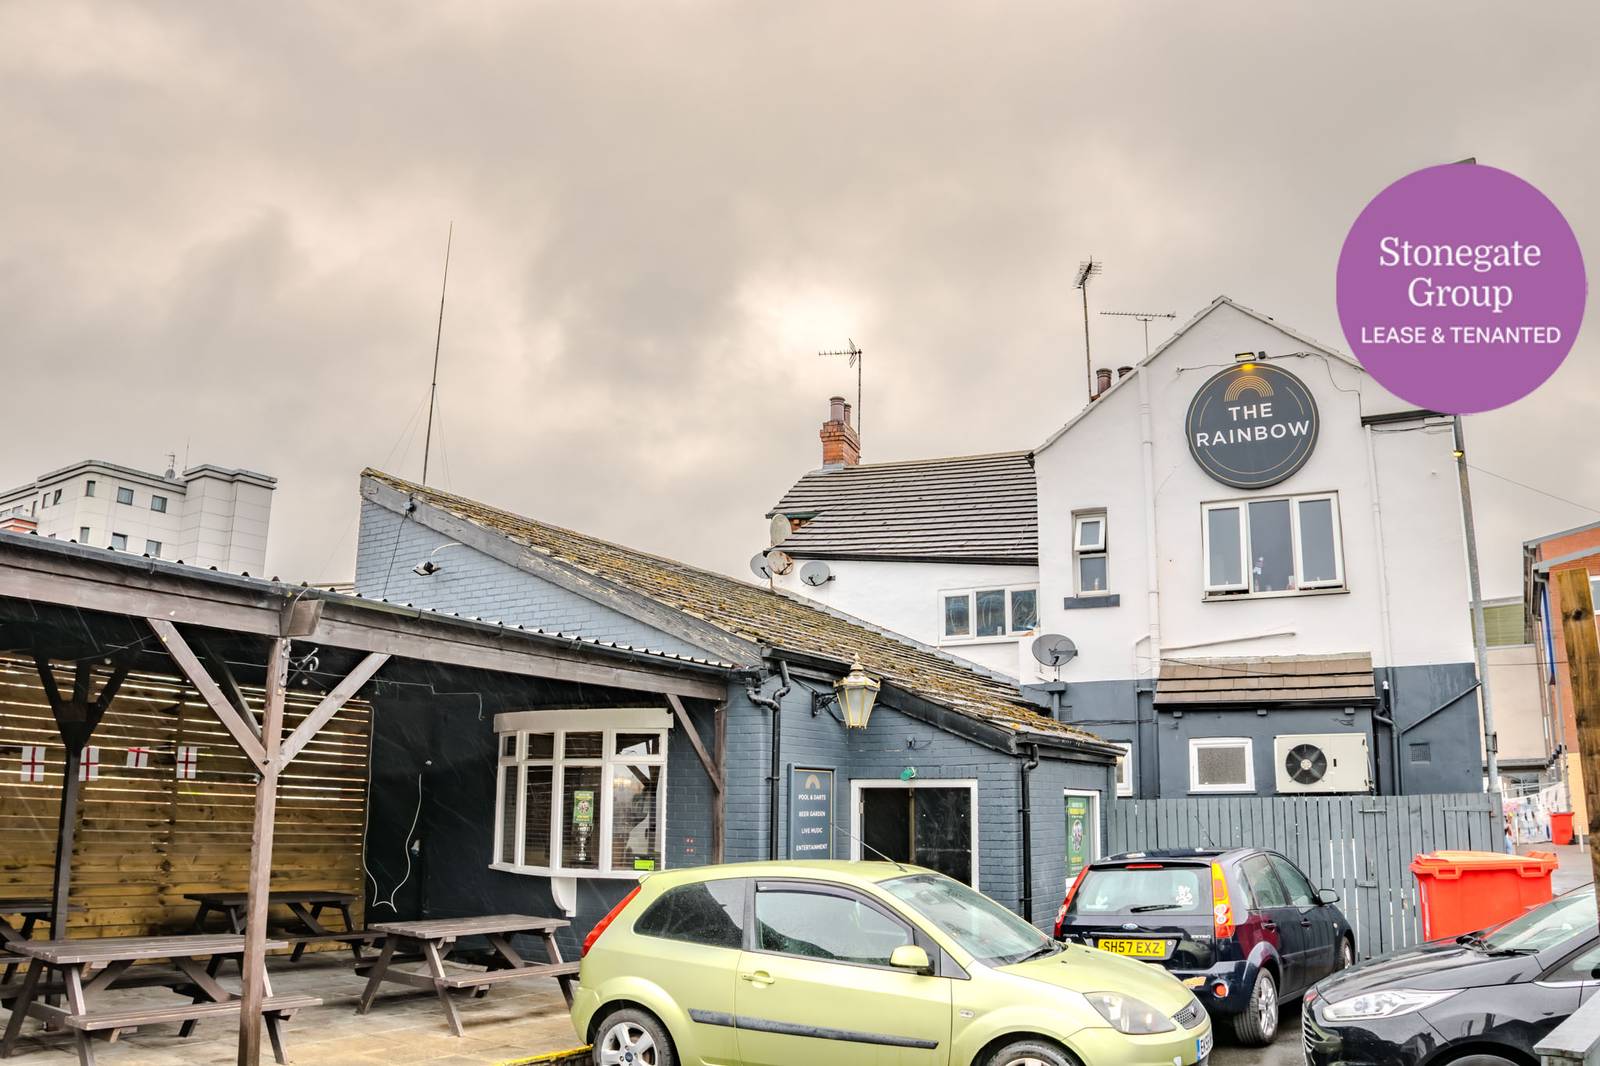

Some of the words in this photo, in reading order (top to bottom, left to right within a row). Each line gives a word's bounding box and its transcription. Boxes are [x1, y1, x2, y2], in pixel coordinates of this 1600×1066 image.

[1228, 402, 1273, 421] THE
[1196, 420, 1309, 447] RAINBOW
[796, 843, 827, 851] ENTERTAINMENT
[1103, 941, 1133, 953] SH57
[1136, 942, 1160, 954] EXZ
